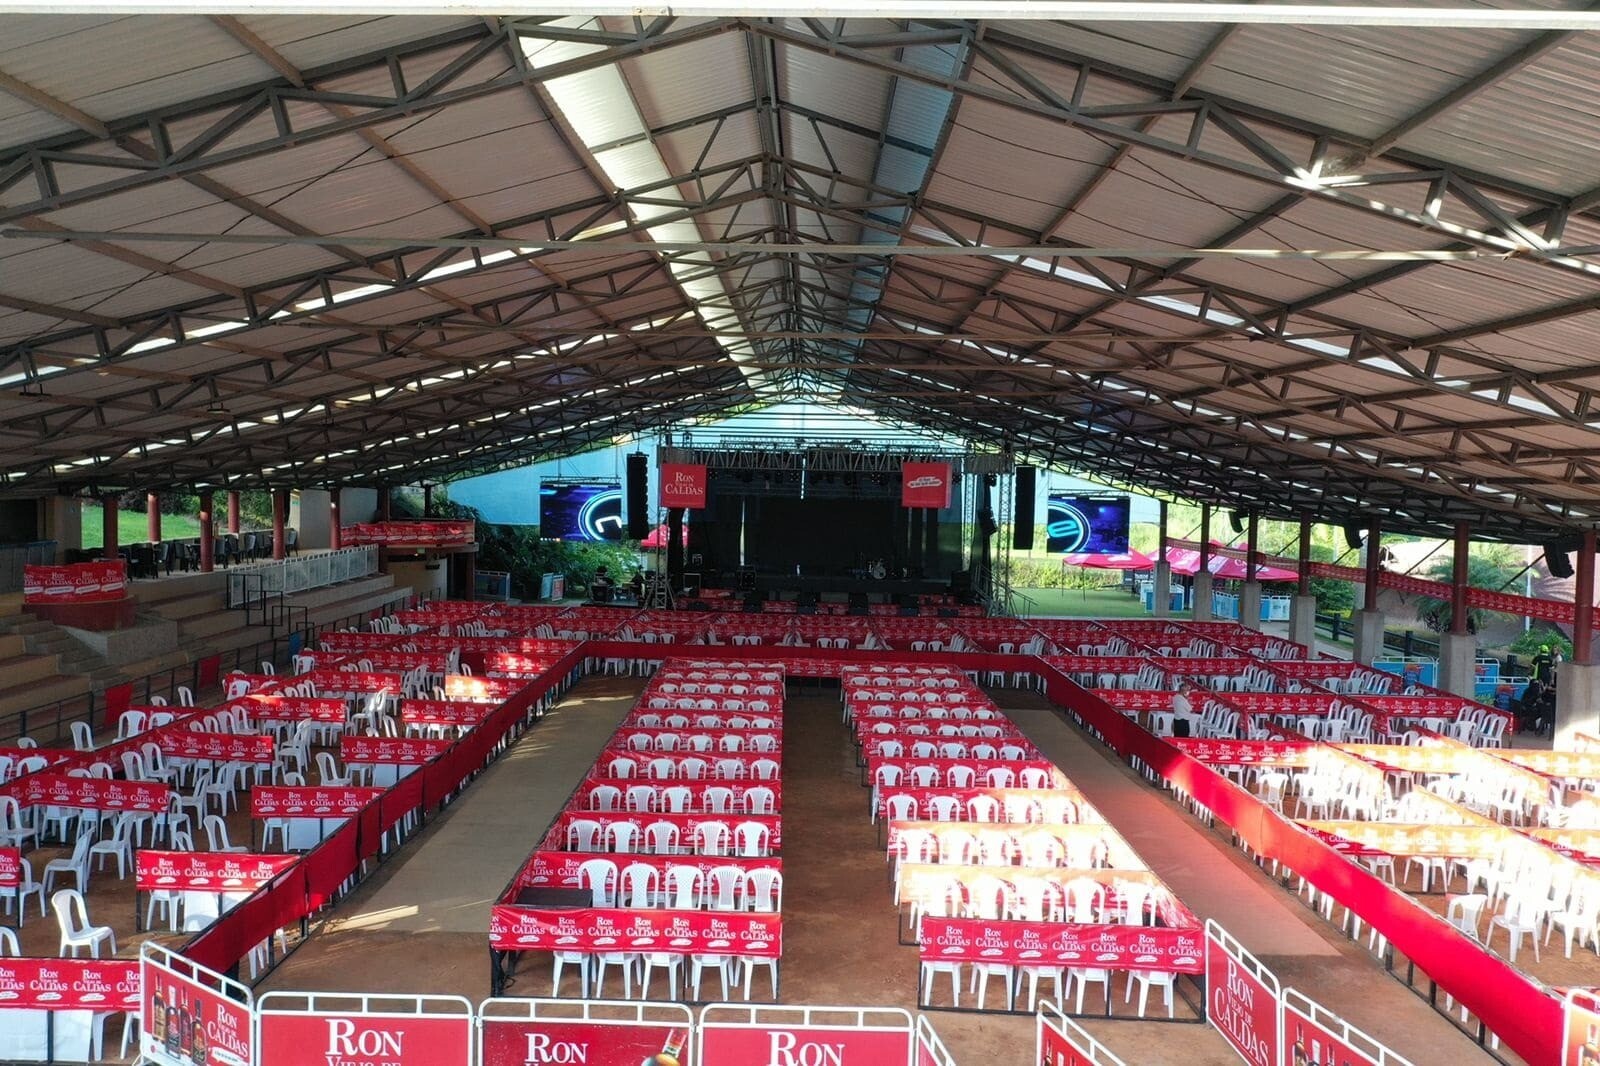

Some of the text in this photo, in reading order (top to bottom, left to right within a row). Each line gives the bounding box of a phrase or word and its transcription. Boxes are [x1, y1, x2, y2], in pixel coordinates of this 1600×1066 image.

[676, 472, 694, 482] RON
[665, 484, 704, 495] CALDAS
[512, 924, 545, 934] CALDAS
[550, 926, 584, 936] CALDAS
[588, 927, 622, 936] CALDAS
[626, 928, 660, 937] CALDAS
[664, 928, 698, 938] CALDAS
[702, 929, 736, 939] CALDAS
[740, 930, 774, 941] CALDAS
[937, 936, 970, 946] CALDAS
[976, 938, 1009, 948] CALDAS
[1014, 940, 1048, 950] CALDAS
[1052, 941, 1086, 952] CALDAS
[1091, 942, 1125, 953] CALDAS
[1130, 944, 1164, 955] CALDAS
[1168, 946, 1202, 958] CALDAS
[40, 968, 58, 978] RON
[82, 969, 102, 980] RON
[0, 980, 24, 990] LDAS
[30, 980, 68, 991] CALDAS
[73, 981, 112, 992] CALDAS
[1227, 956, 1254, 1011] RON
[216, 1004, 238, 1028] RON
[1214, 987, 1268, 1066] CALDAS
[208, 1020, 248, 1058] CALDAS
[325, 1018, 404, 1056] RON
[525, 1033, 588, 1064] RON
[768, 1031, 845, 1066] RON
